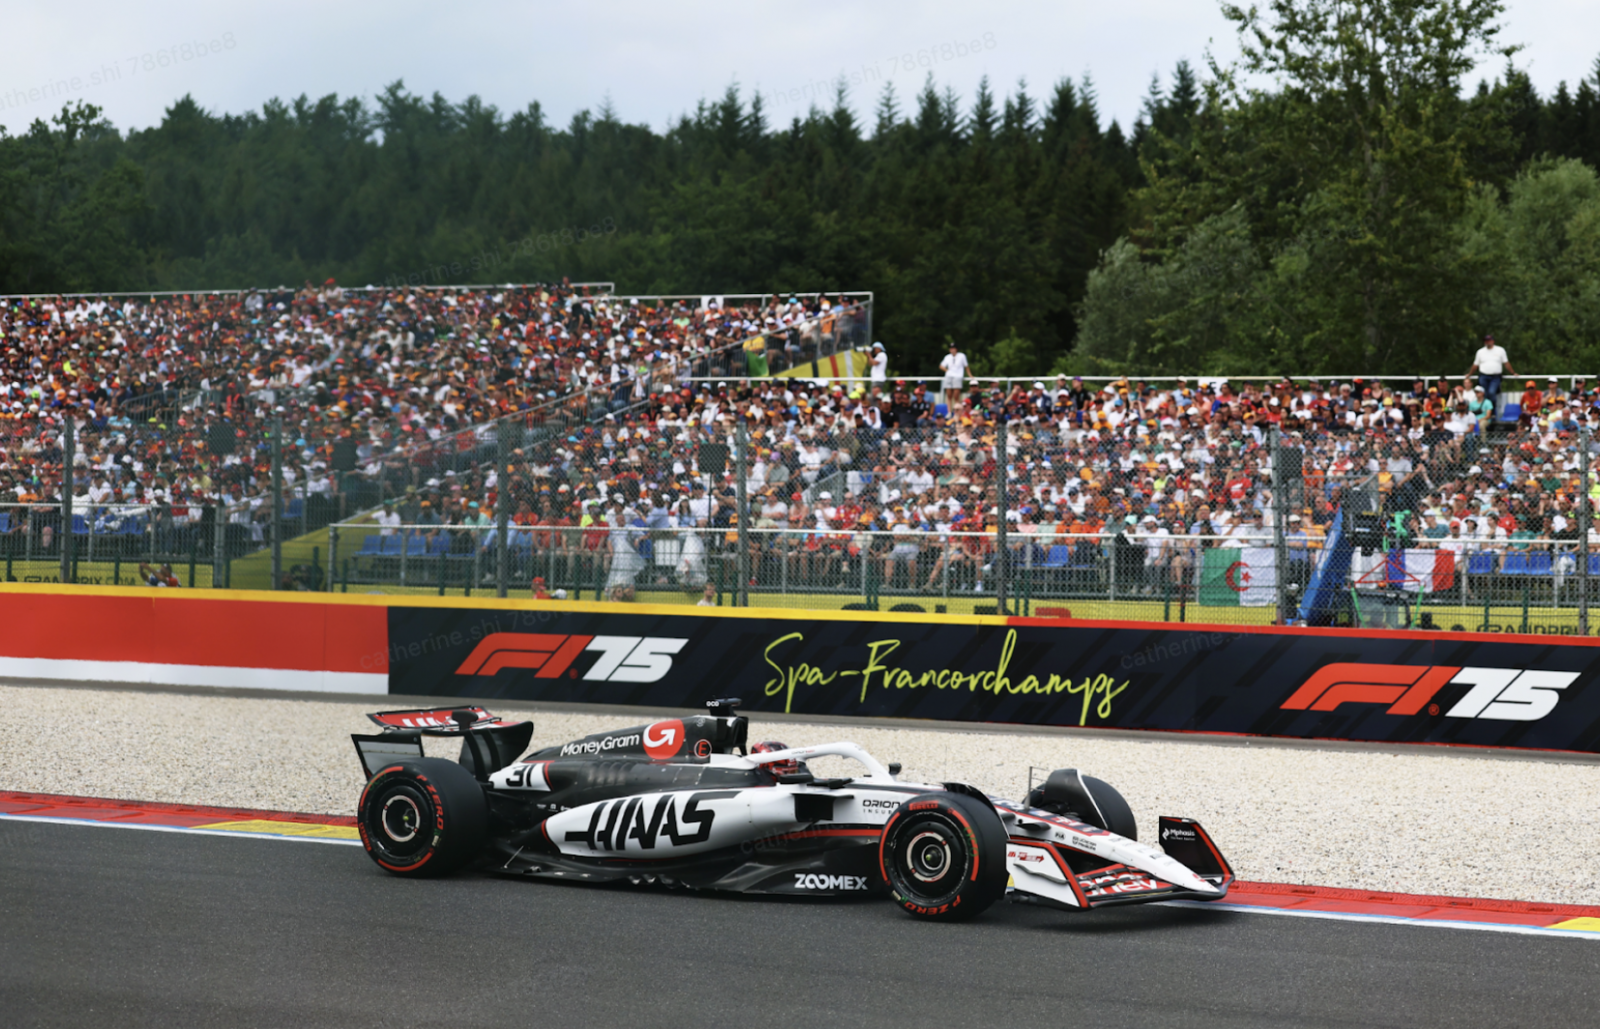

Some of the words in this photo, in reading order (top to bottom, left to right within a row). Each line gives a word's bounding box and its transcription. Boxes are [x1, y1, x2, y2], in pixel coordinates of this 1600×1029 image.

[454, 632, 595, 678] F1
[582, 635, 690, 683] 75
[764, 628, 1130, 726] Spa-Francorchamps
[1279, 662, 1463, 716] F1
[1444, 666, 1583, 722] 75
[560, 734, 640, 757] MoneyGram
[506, 763, 537, 788] 31
[565, 790, 743, 851] HAAS
[1170, 829, 1195, 837] Mphasis
[794, 873, 868, 890] ZOOMEX
